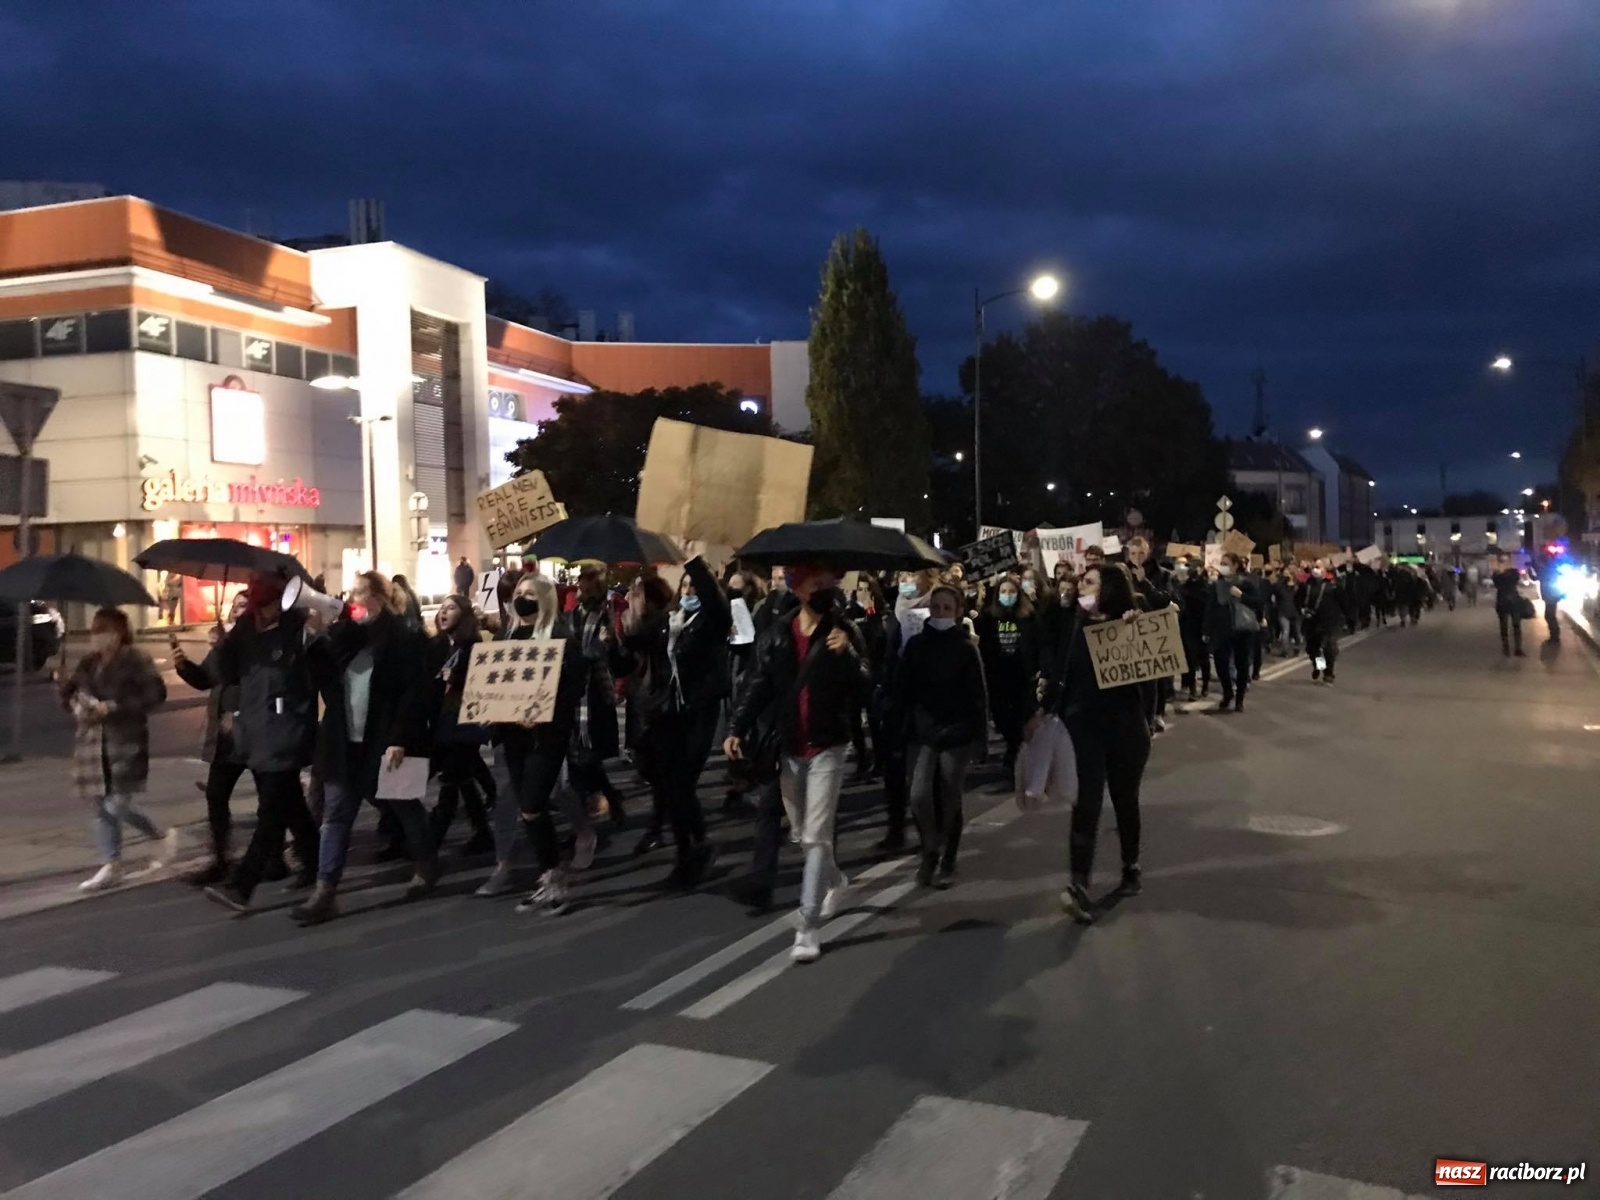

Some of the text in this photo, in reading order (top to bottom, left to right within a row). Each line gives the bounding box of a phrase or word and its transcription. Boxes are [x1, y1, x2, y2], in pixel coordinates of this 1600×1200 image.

[45, 318, 75, 341] 4F
[139, 315, 170, 337] 4F
[246, 340, 270, 360] 4F
[143, 469, 229, 511] galeria
[477, 478, 538, 511] REAL MEN
[486, 501, 556, 541] FEMINISTS
[497, 497, 528, 520] ARE
[1091, 612, 1170, 645] TO JEST
[1096, 635, 1170, 664] WOJNA Z
[1100, 653, 1180, 684] KOBIETAMI
